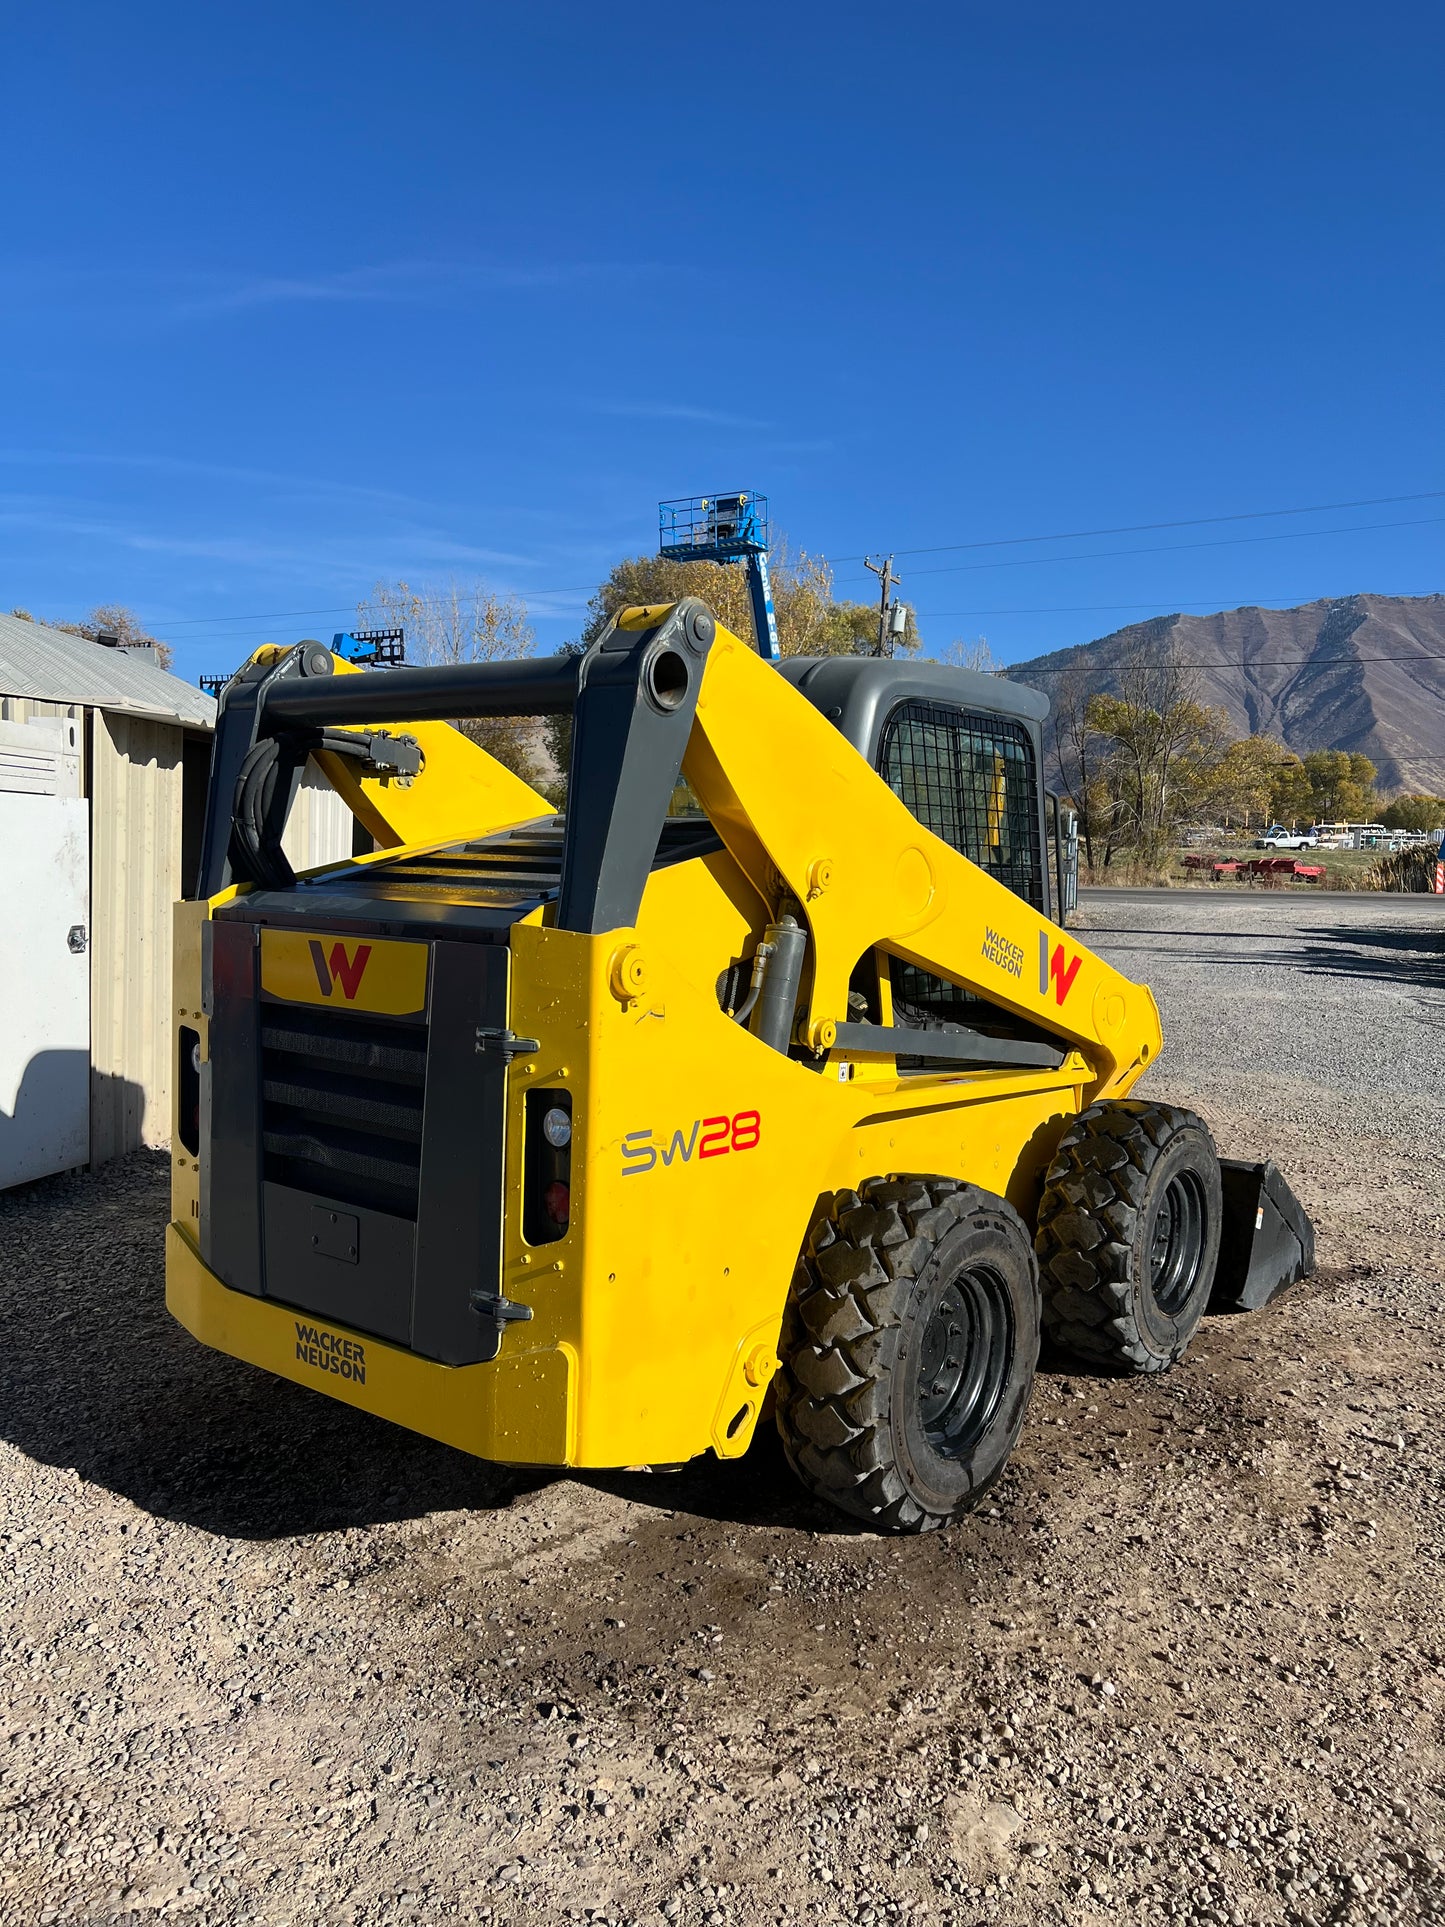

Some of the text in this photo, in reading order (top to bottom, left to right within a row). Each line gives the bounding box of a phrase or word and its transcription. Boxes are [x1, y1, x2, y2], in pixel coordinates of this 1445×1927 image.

[759, 552, 780, 654] Genie S-65
[981, 941, 1022, 979] NEUSON
[985, 925, 1024, 964] WACKER
[621, 1110, 761, 1176] SW28
[295, 1321, 366, 1366] WACKER
[296, 1341, 366, 1386] NEUSON
